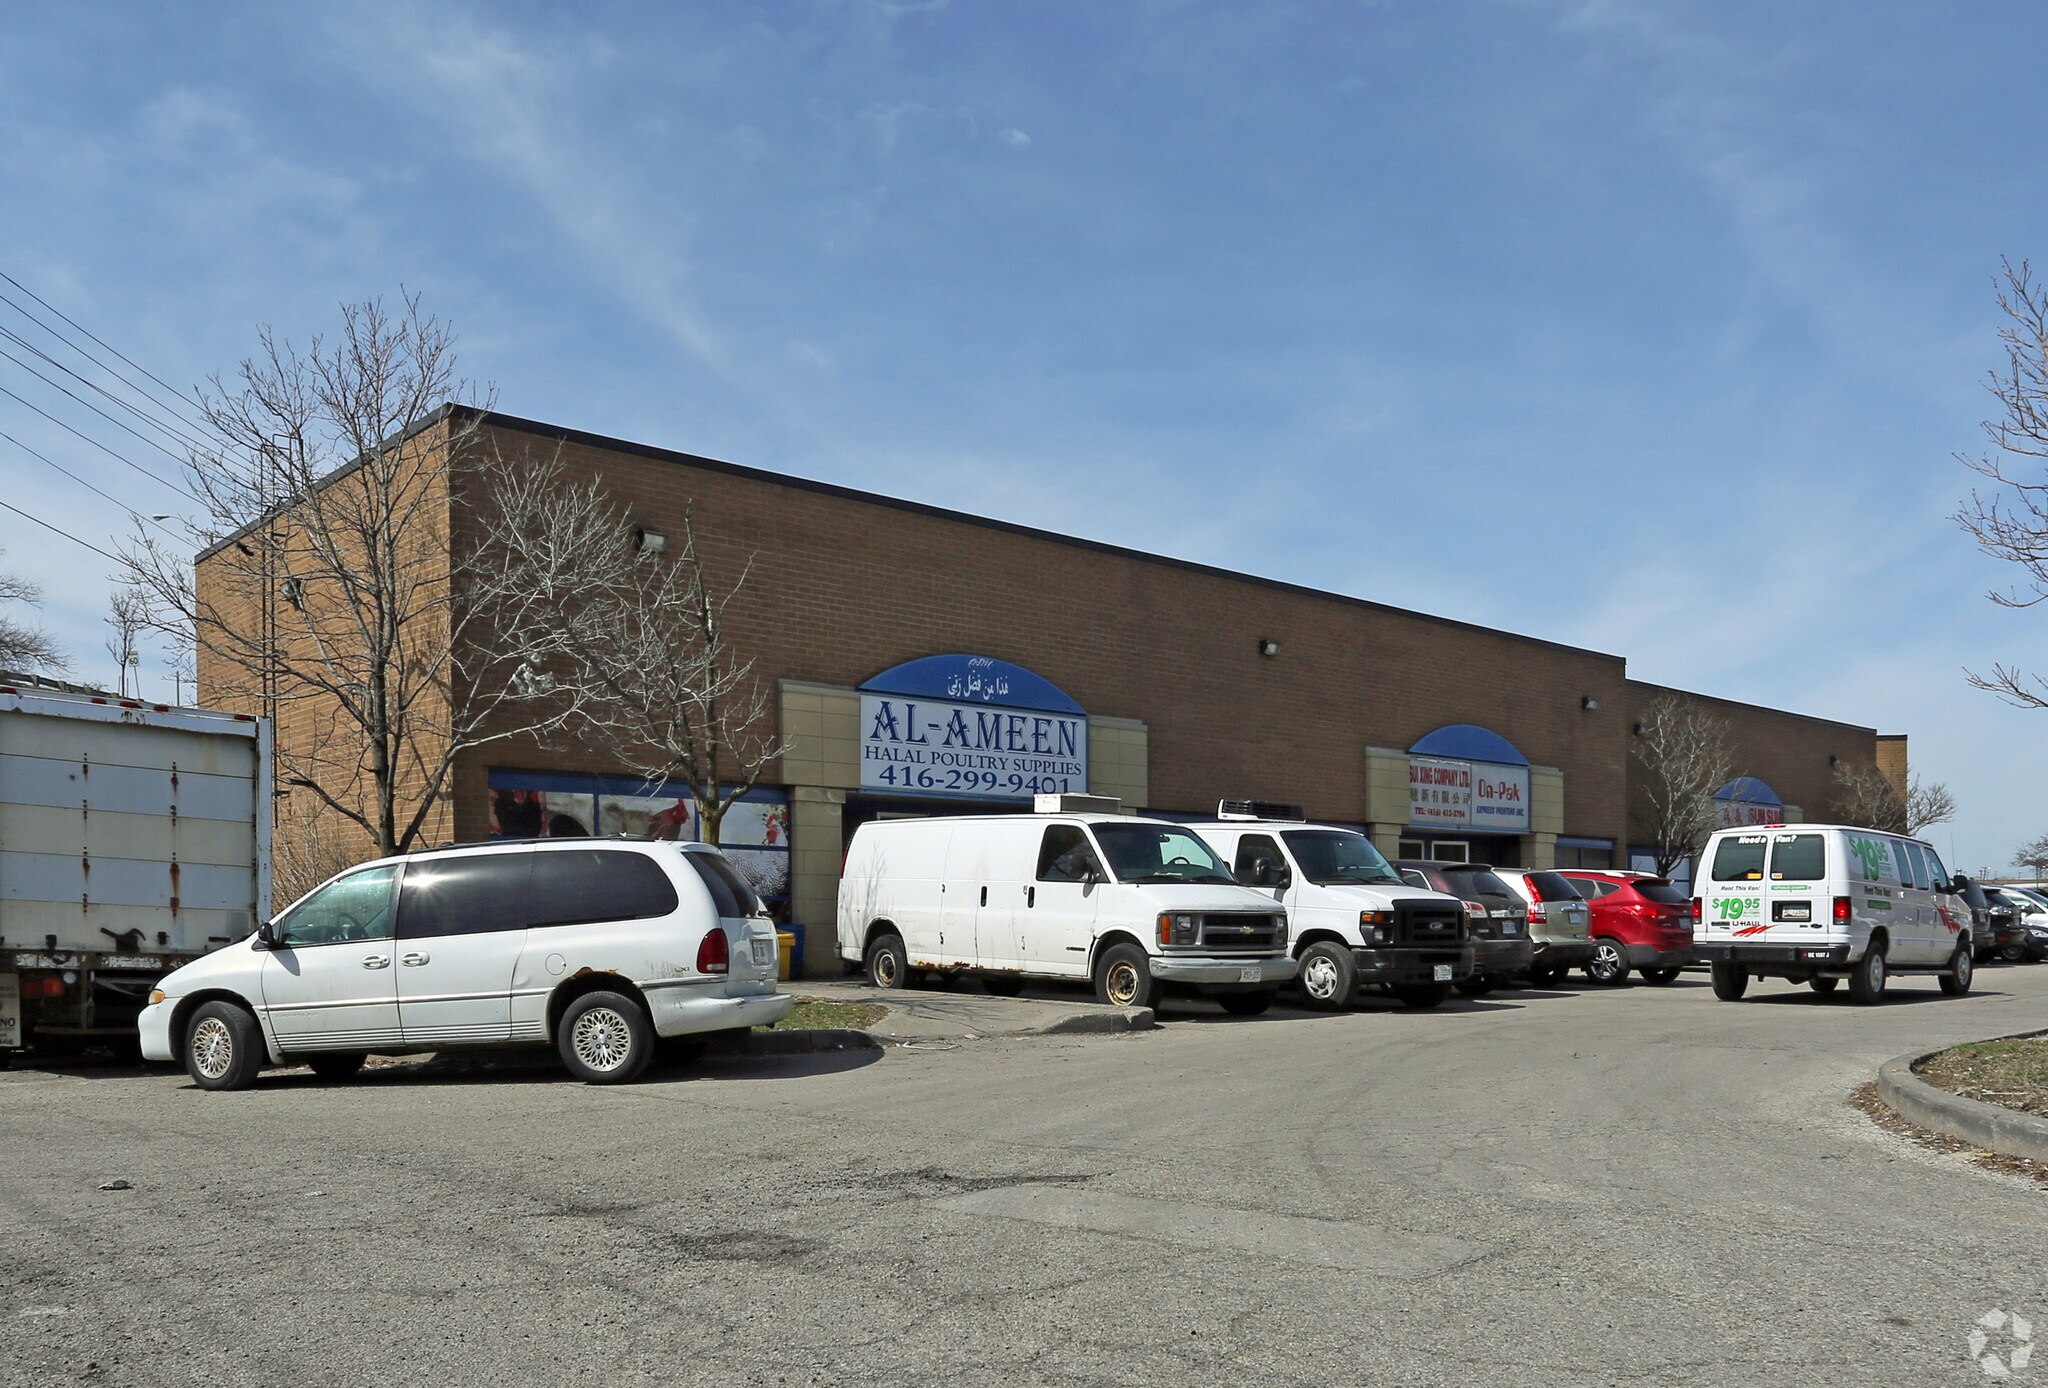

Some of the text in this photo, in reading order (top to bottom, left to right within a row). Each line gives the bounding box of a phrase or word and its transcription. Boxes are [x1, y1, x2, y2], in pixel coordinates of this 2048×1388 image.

[870, 701, 1079, 759] AL-AMEEN
[864, 745, 1082, 776] HALAL POULTRY SUPPLIES
[879, 765, 1069, 794] 416-299-9401
[1434, 767, 1459, 787] COMPANY
[1478, 779, 1520, 801] On-Pak
[1476, 805, 1495, 815] EXPRESS
[1738, 836, 1760, 844] Need
[1775, 835, 1797, 843] Van?
